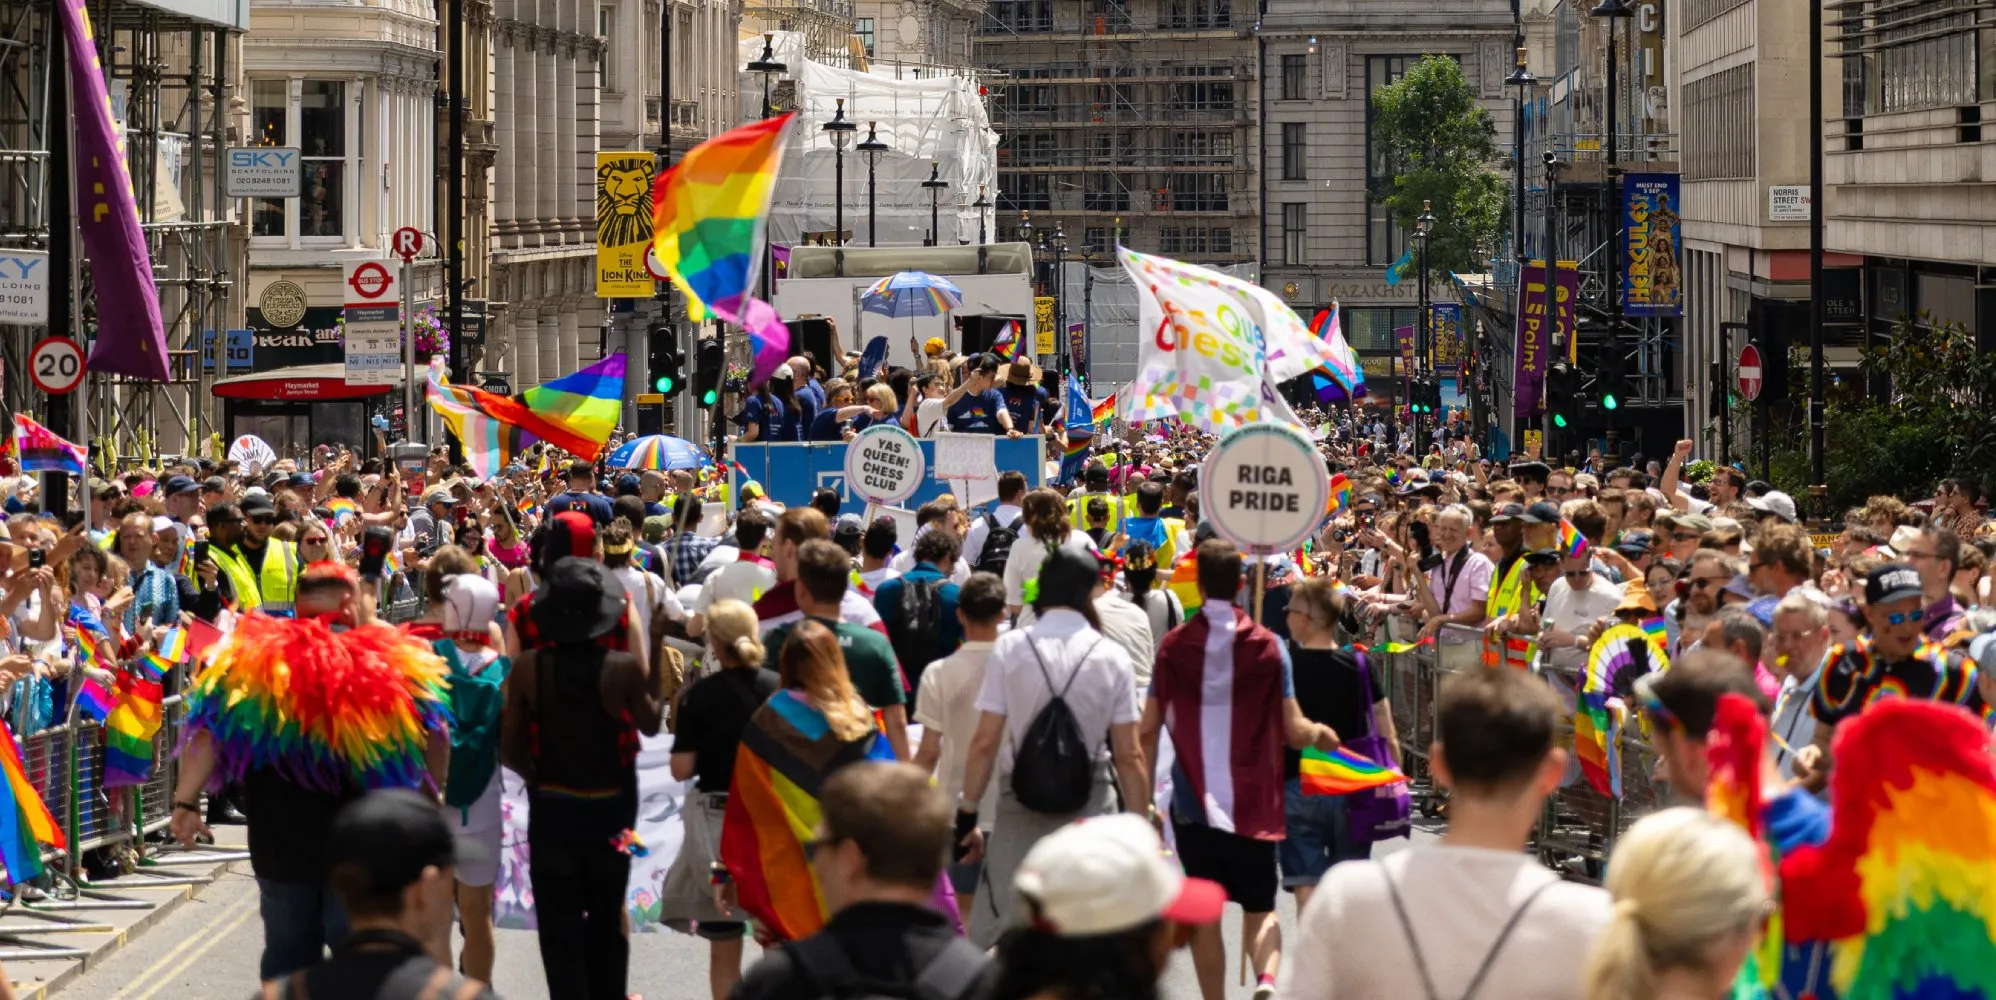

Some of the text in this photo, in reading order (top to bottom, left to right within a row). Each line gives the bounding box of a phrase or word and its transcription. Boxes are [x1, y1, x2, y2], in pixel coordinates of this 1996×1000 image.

[231, 151, 294, 167] SKY
[1773, 188, 1799, 196] NORRIS
[1773, 196, 1799, 204] STREET
[400, 230, 417, 253] R
[1628, 201, 1650, 303] HERCULES
[601, 268, 650, 282] LION KING
[1327, 283, 1439, 298] KAZAKHSTN
[1827, 306, 1856, 315] STEEN
[466, 322, 479, 330] and
[1522, 316, 1541, 373] Point
[204, 347, 250, 360] NRO
[38, 353, 78, 377] 20
[284, 382, 319, 390] Haymarket
[878, 438, 902, 454] YAS
[863, 447, 910, 469] QUEEN!
[862, 461, 904, 481] CHESS
[1238, 464, 1293, 486] RIGA
[864, 475, 897, 491] CLUB
[1229, 489, 1299, 513] PRIDE
